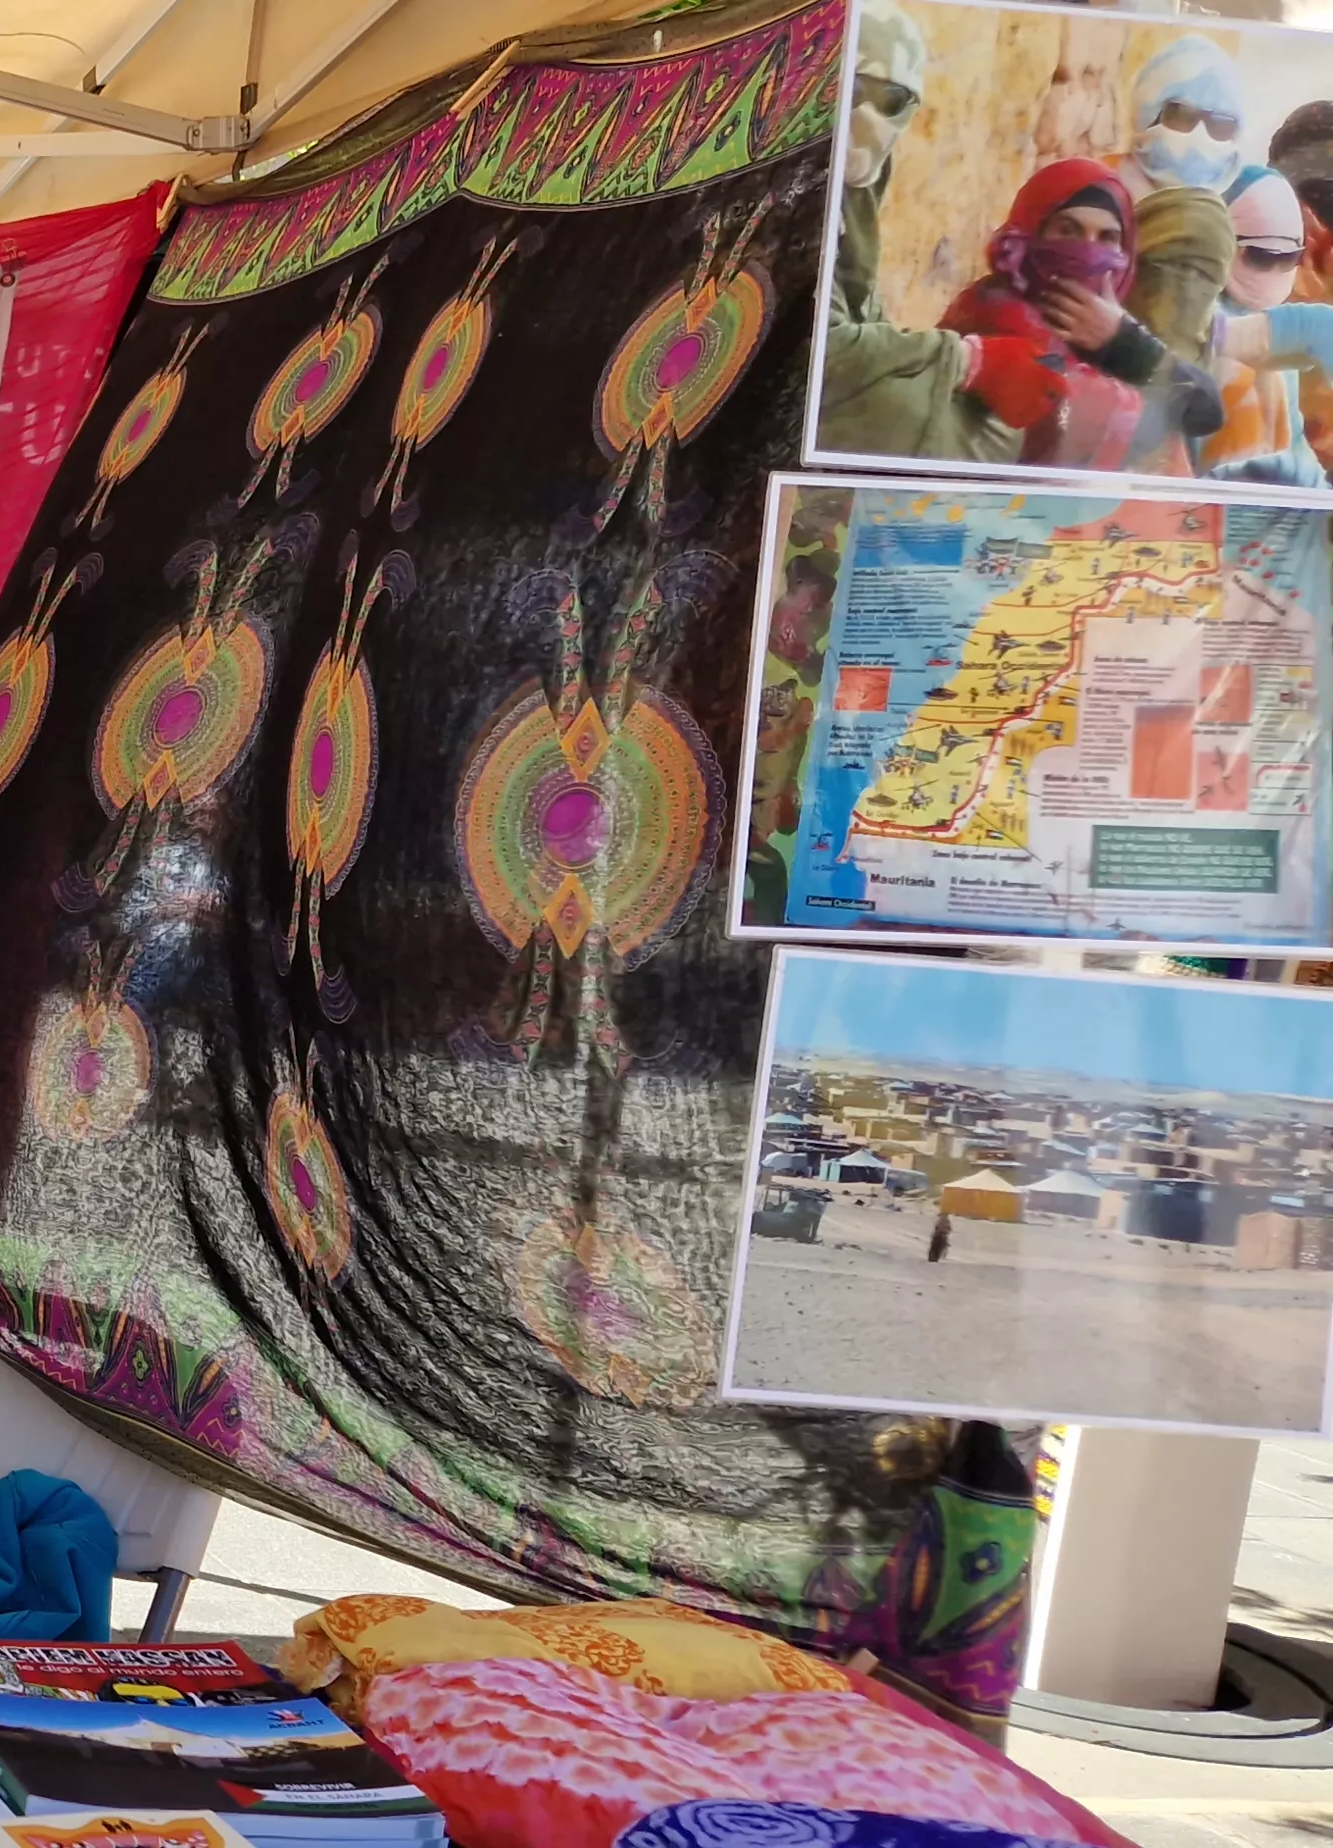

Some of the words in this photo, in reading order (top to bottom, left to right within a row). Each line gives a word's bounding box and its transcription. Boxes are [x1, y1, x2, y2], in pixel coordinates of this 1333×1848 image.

[870, 873, 936, 888] Mauritania
[40, 1664, 83, 1674] digo
[87, 1665, 106, 1674] al
[109, 1667, 178, 1676] mundo
[182, 1668, 244, 1677] entero
